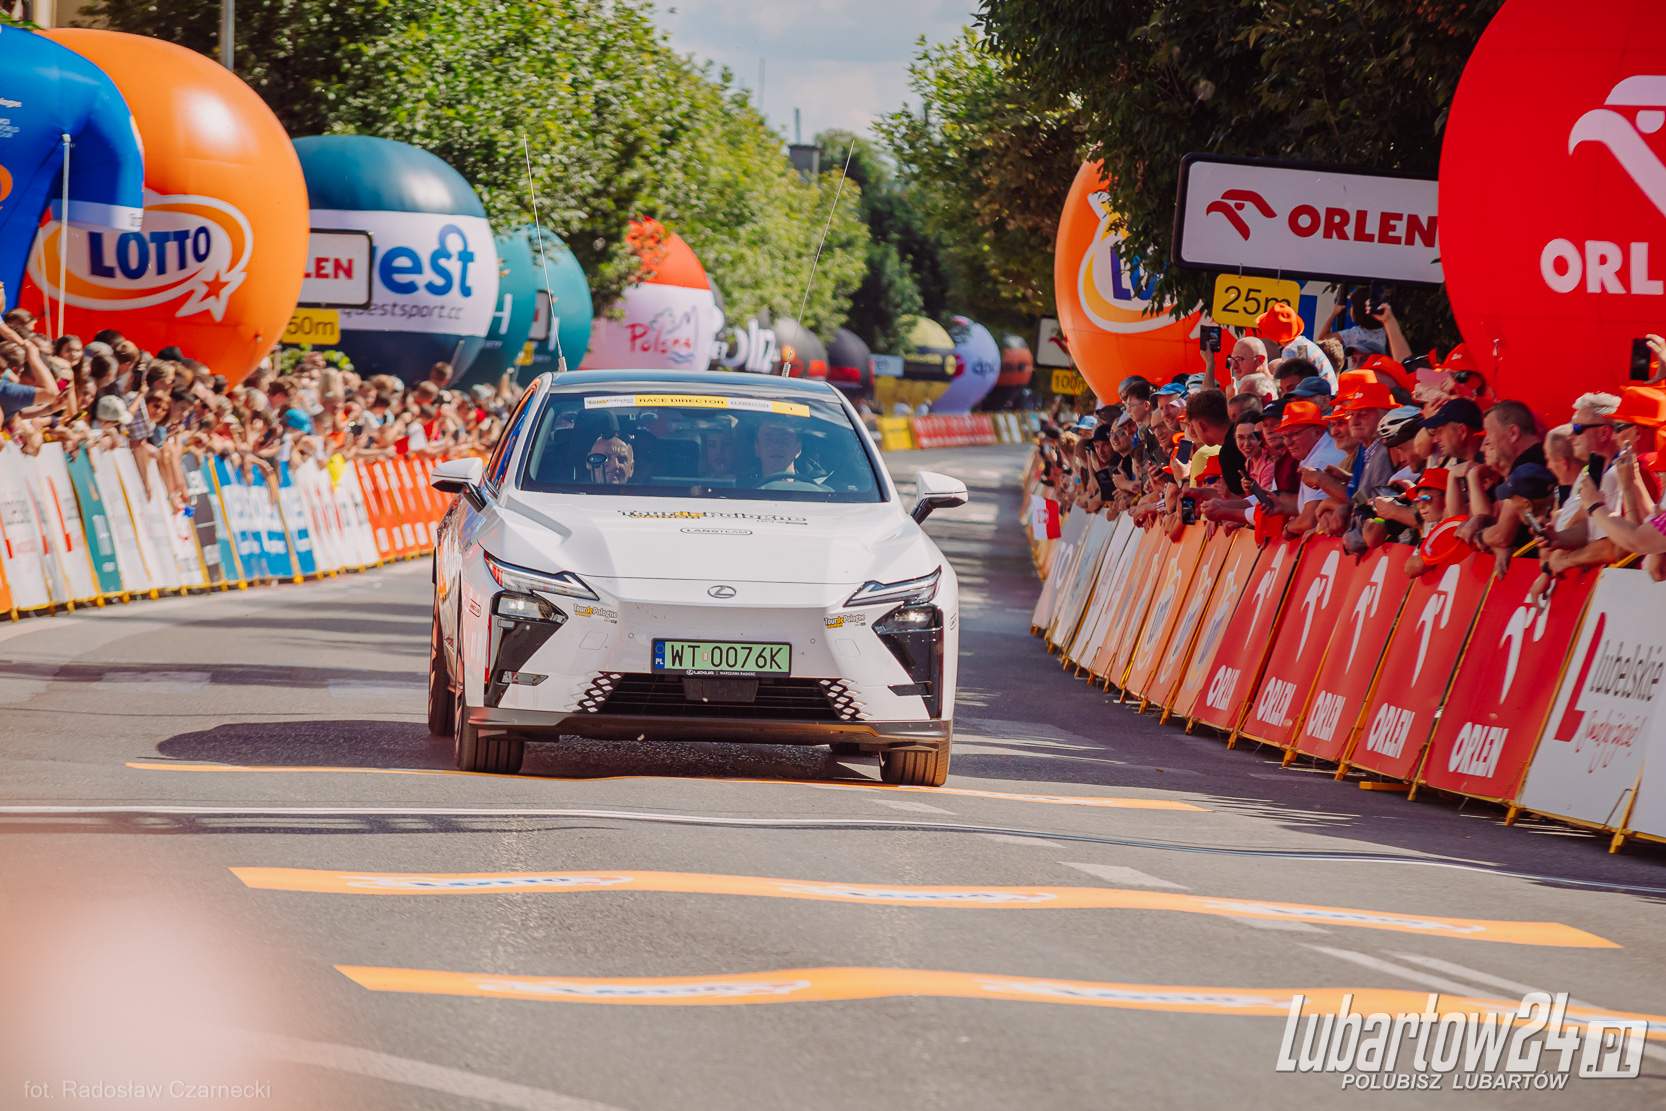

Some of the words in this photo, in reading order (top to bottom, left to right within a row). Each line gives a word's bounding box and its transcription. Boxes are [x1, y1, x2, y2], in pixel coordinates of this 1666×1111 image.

[88, 226, 212, 280] LOTTO
[1287, 204, 1438, 248] ORLEN
[303, 256, 354, 280] EN
[371, 224, 475, 298] est
[670, 644, 701, 668] WT
[710, 645, 783, 670] 0076K
[1366, 702, 1416, 760] ORLEN
[1448, 721, 1510, 779] ORLEN
